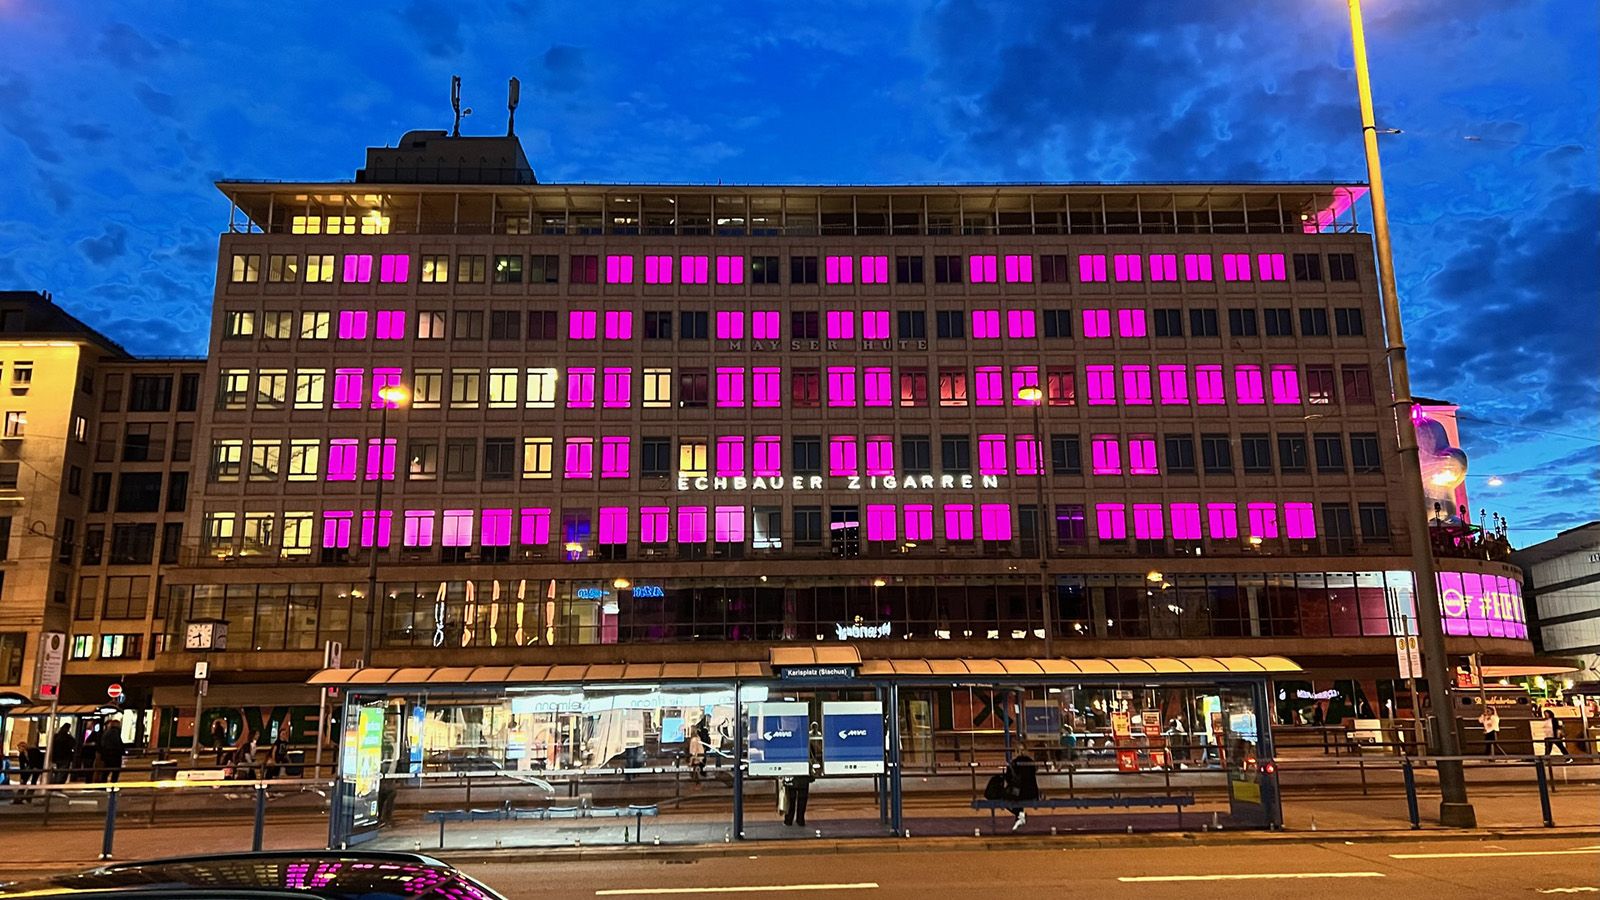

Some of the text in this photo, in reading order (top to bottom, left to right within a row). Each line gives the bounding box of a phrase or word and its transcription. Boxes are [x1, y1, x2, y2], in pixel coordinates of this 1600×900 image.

[729, 340, 839, 351] MAYSER
[847, 474, 998, 490] ZIGARREN
[787, 669, 818, 677] Karlsplatz
